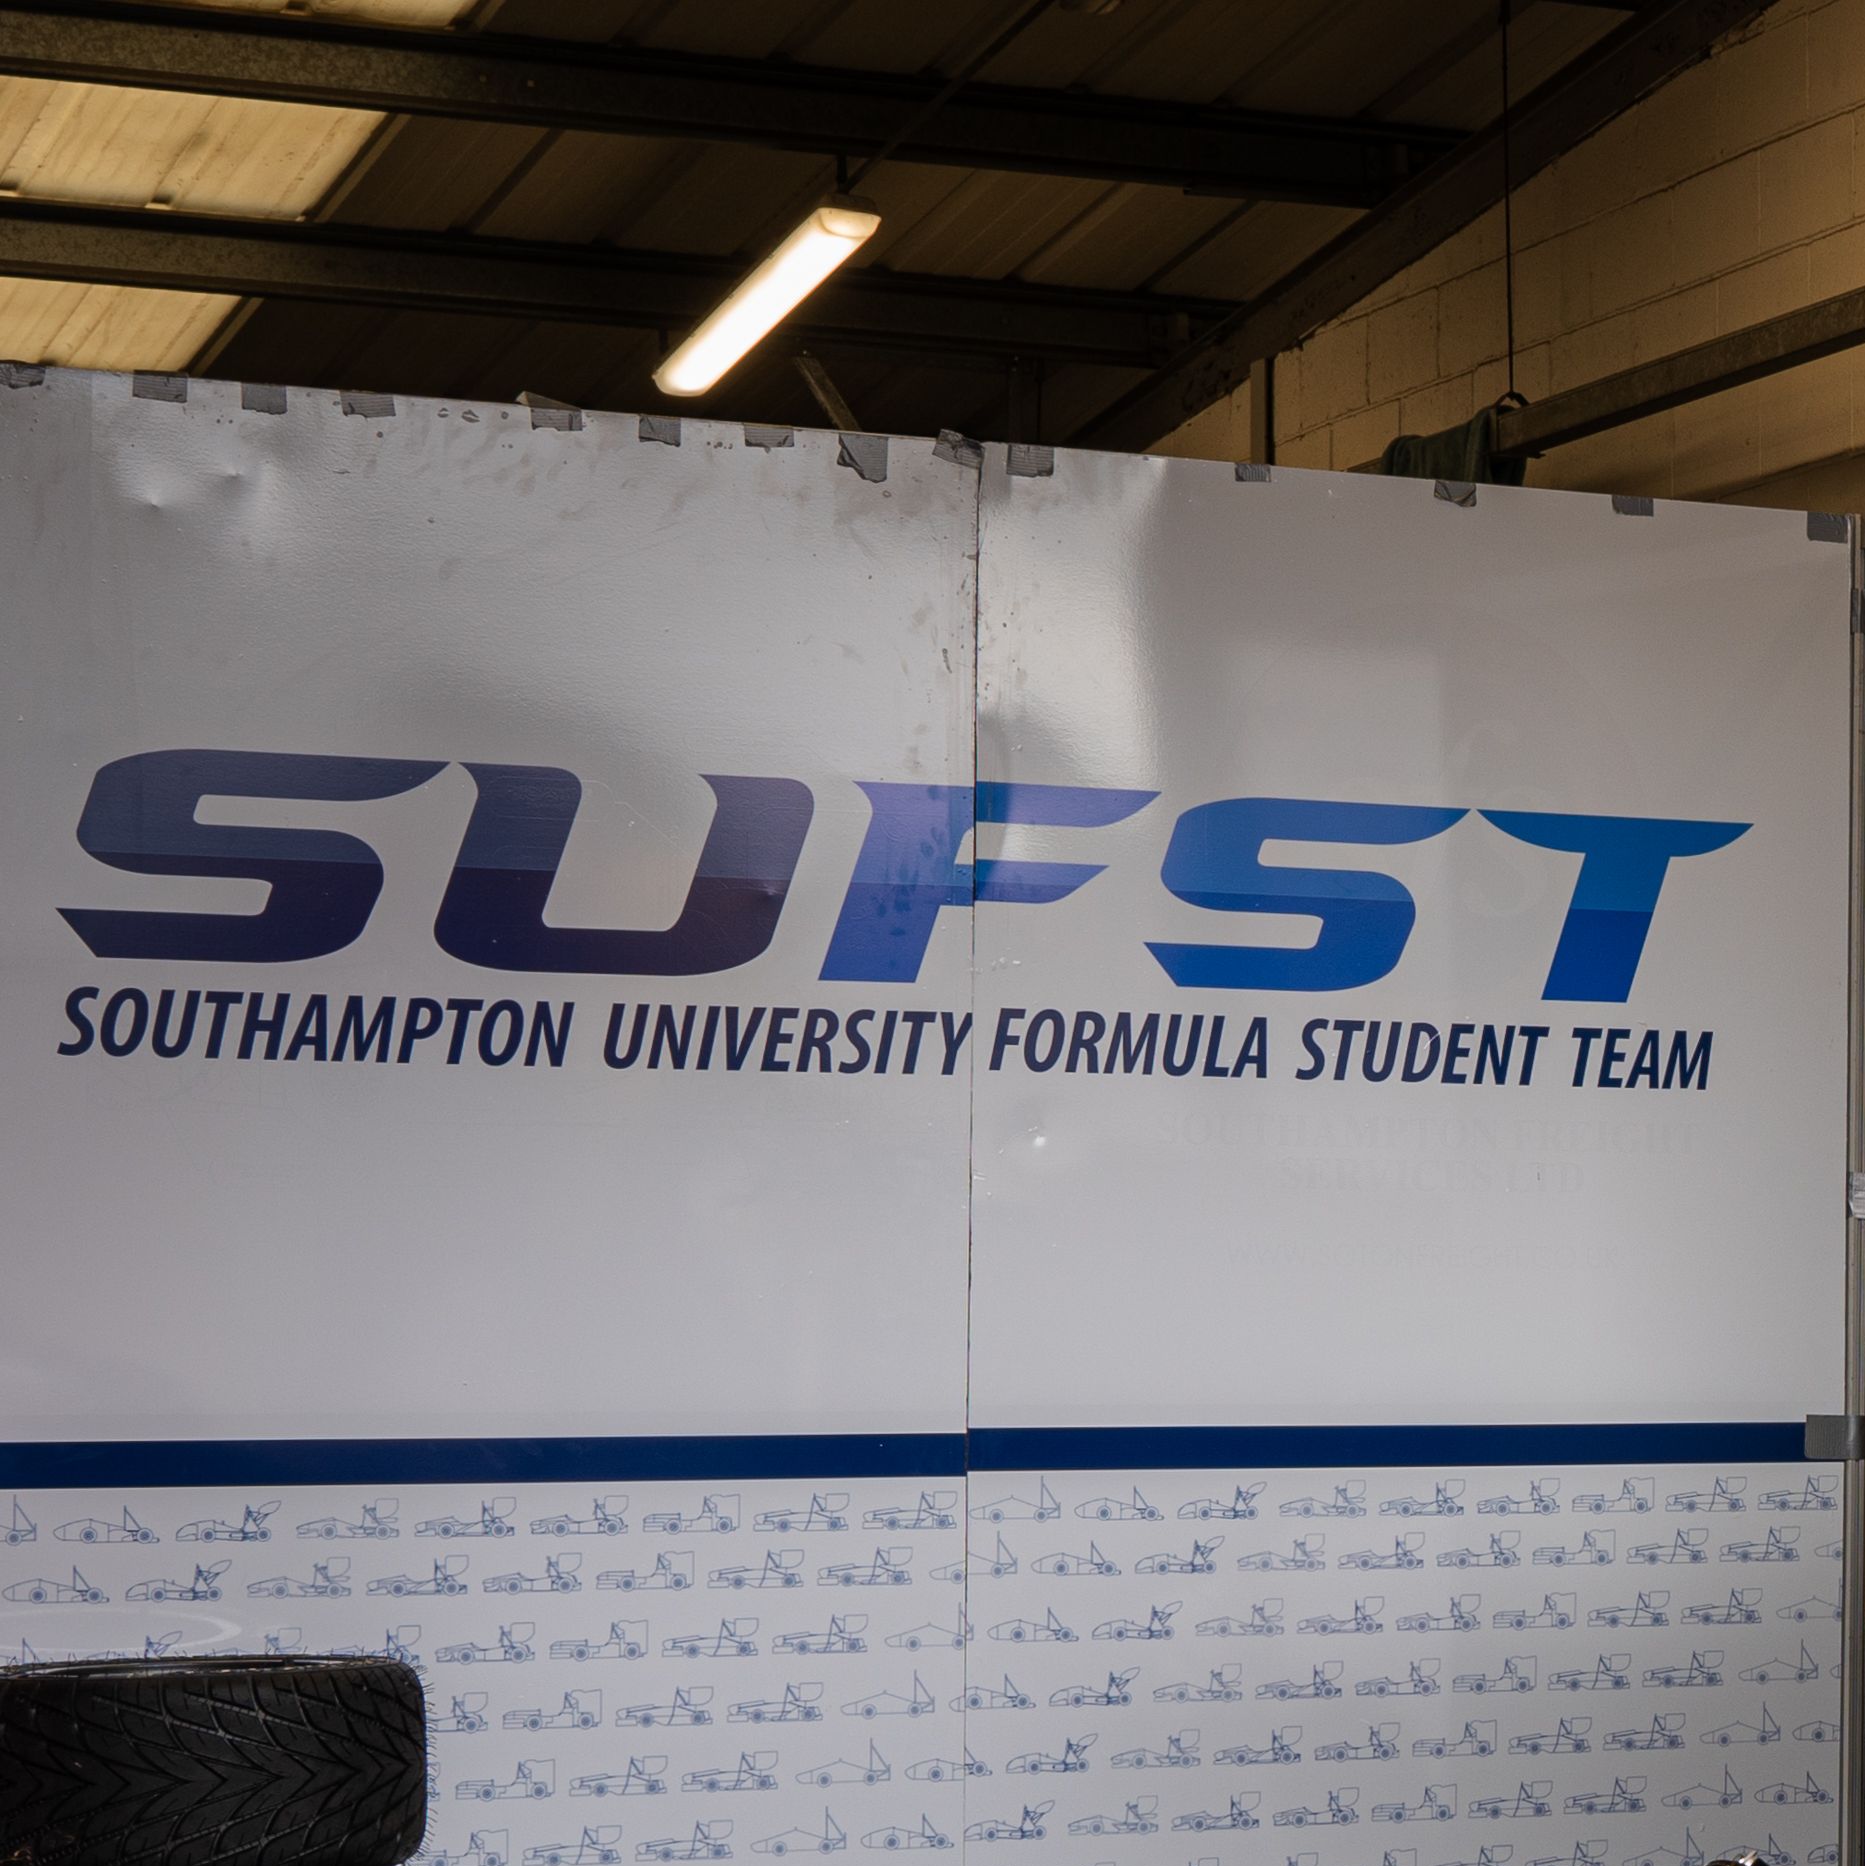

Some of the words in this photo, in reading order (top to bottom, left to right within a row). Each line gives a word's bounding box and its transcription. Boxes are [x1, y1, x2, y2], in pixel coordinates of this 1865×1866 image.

[56, 748, 1754, 1004] SUFST
[56, 985, 573, 1071] SOUTHAMPTON
[603, 1002, 974, 1080] UNIVERSITY
[988, 1008, 1270, 1080] FORMULA
[1295, 1017, 1549, 1086] STUDENT
[1571, 1027, 1713, 1091] TEAM
